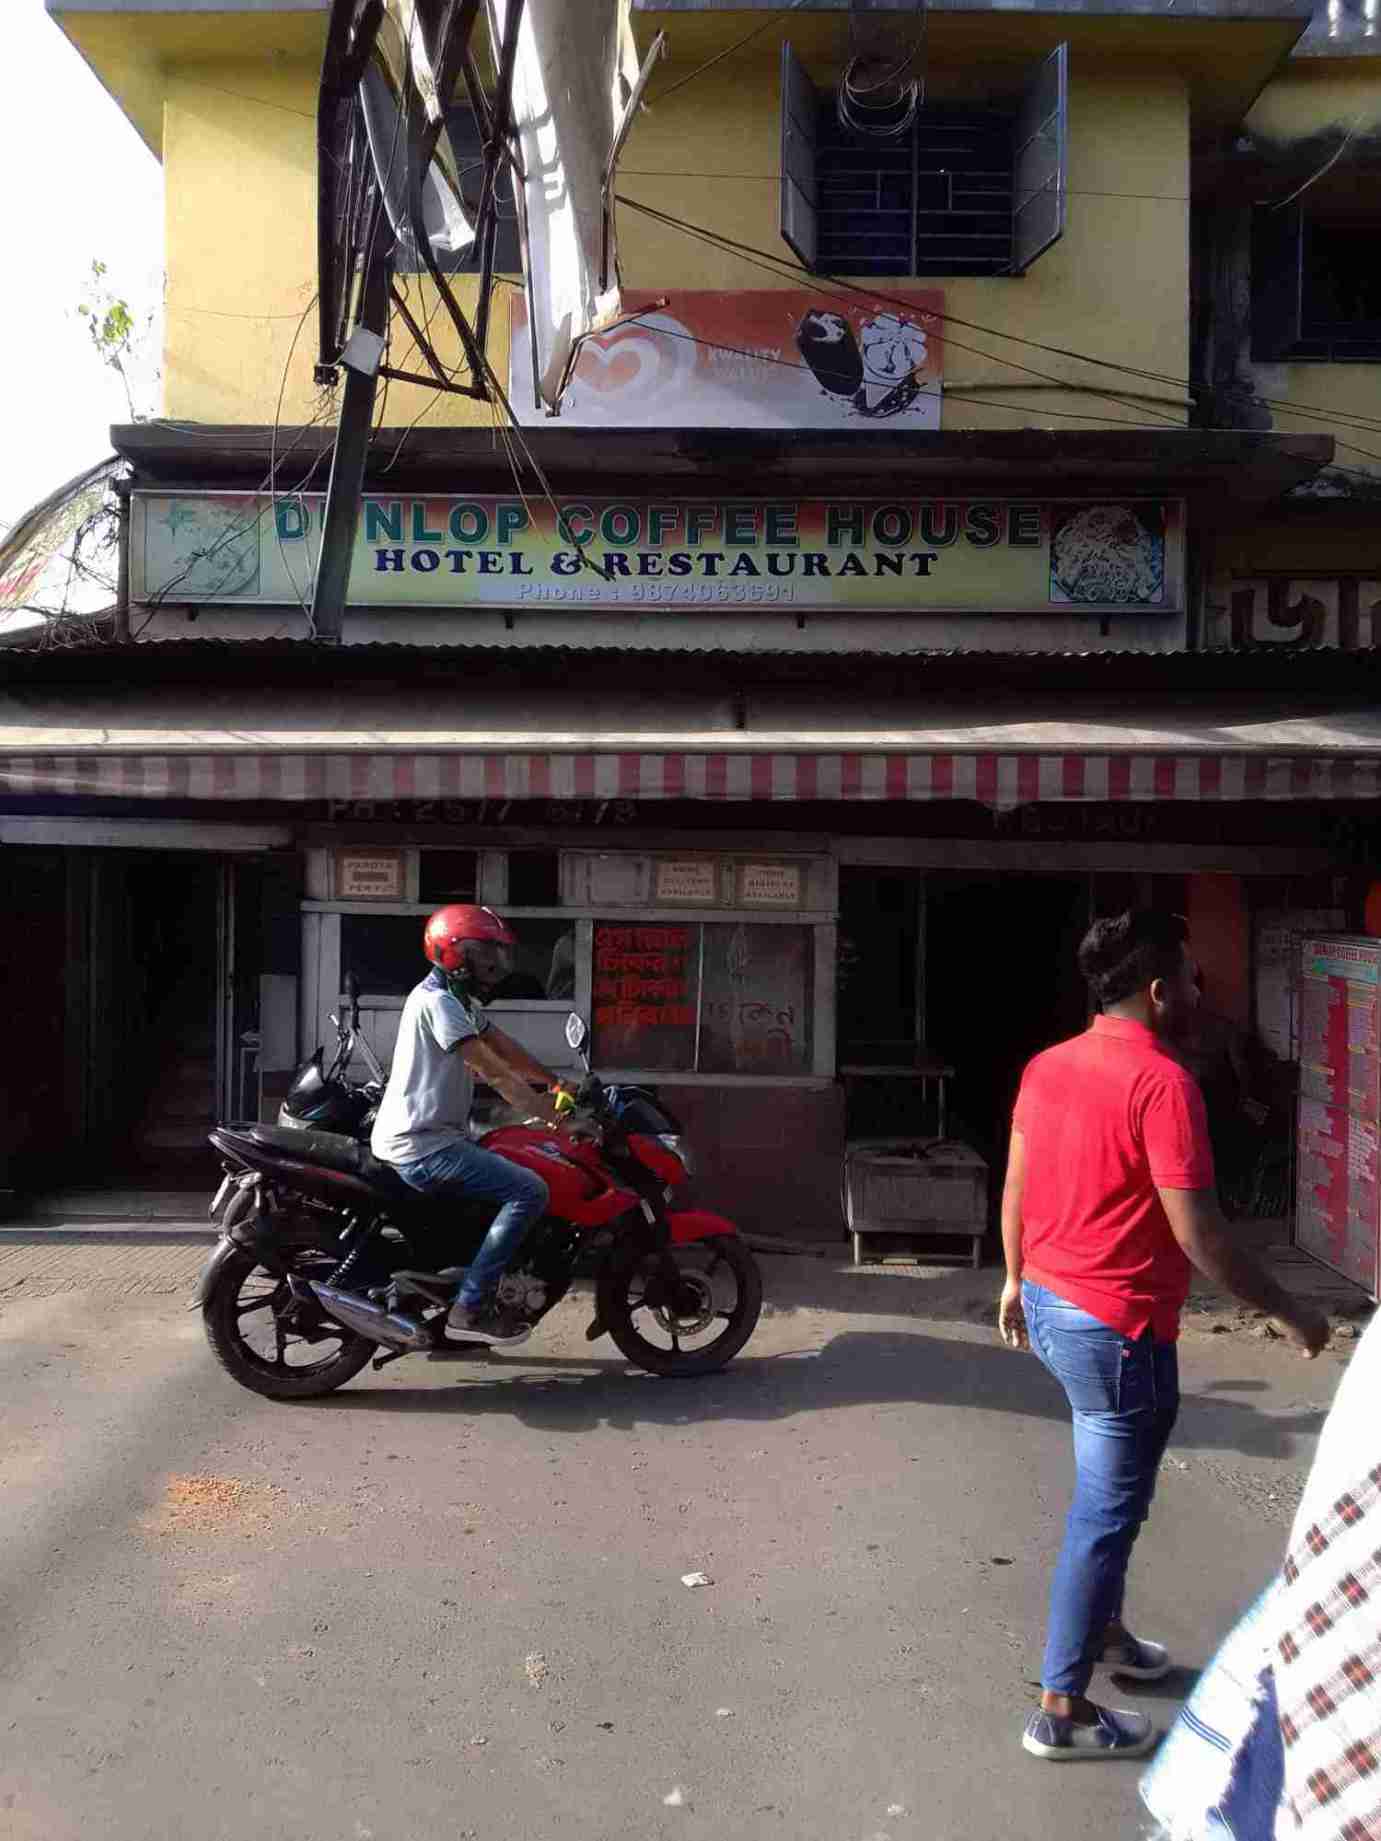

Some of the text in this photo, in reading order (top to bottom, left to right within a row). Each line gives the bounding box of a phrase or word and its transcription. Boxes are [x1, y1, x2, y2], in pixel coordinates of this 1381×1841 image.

[275, 500, 1042, 548] DNLOP COFFEE HOUSE
[374, 548, 938, 577] HOTEL & RESTAURANT
